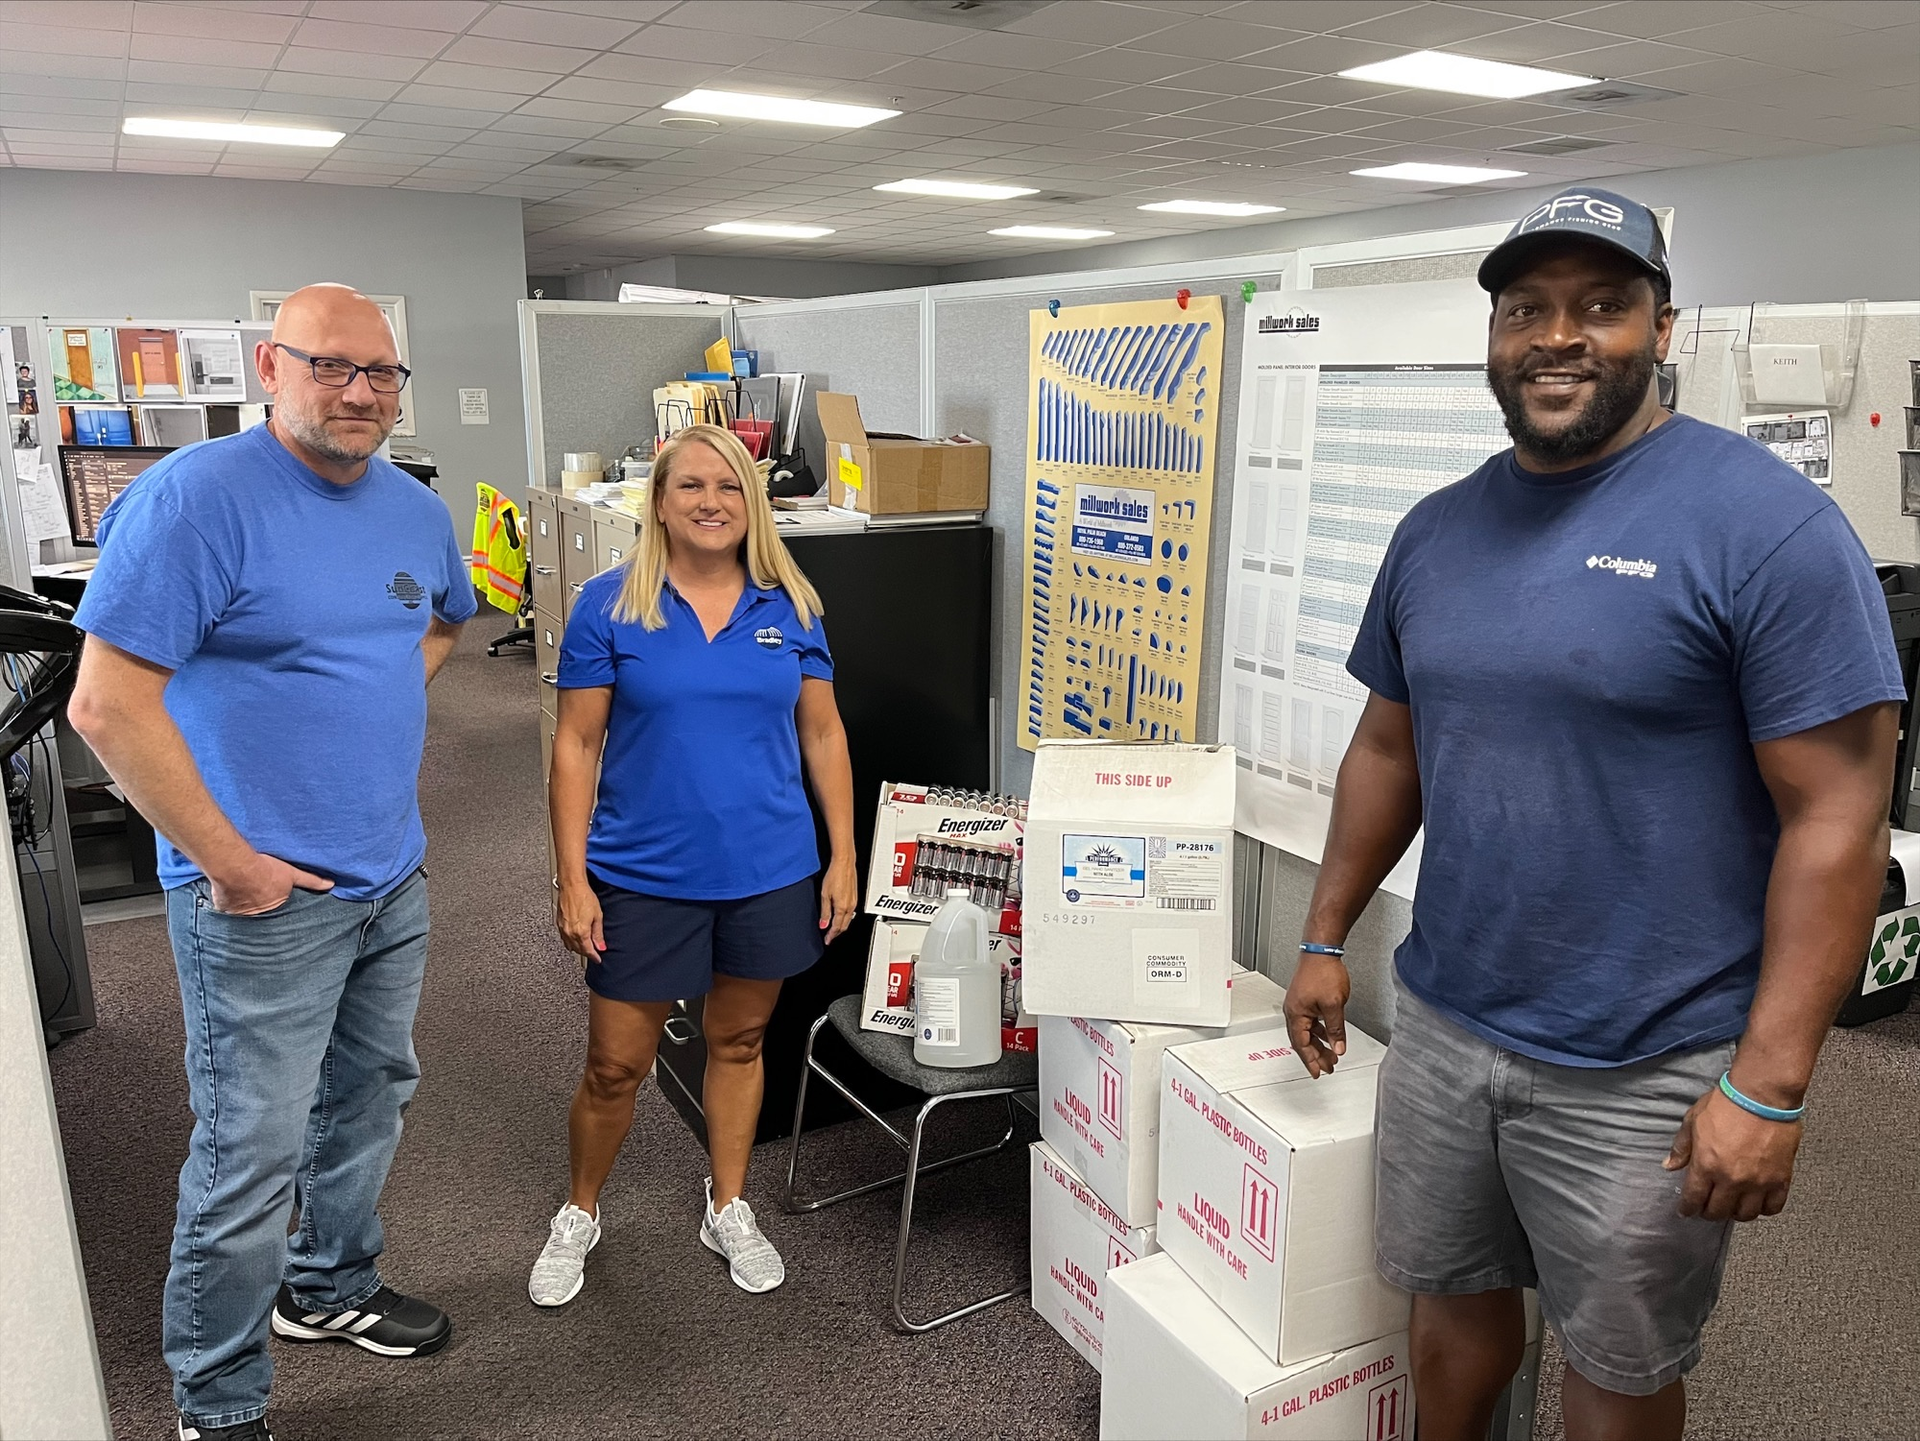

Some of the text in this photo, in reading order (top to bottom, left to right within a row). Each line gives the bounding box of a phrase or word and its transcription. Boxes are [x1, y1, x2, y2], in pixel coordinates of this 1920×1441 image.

[1518, 195, 1623, 235] PFG
[1259, 314, 1320, 329] millwork sales
[1080, 495, 1148, 518] millwork sales
[1598, 556, 1657, 572] Columbia
[1095, 773, 1172, 788] THIS SIDE UP
[938, 817, 1008, 835] Energizer
[1176, 843, 1214, 852] PP-28176
[875, 894, 940, 915] Energizer
[1043, 914, 1095, 924] 549297
[1016, 1032, 1024, 1044] C
[1090, 1026, 1115, 1057] BOTTLES
[1248, 1048, 1292, 1061] SIDE UP
[1065, 1087, 1091, 1125] LIQUID
[1171, 1078, 1267, 1165] 4-1 GAL. PLASTIC BOTTLES
[1054, 1097, 1104, 1158] HANDLE WITH CARE
[1043, 1160, 1128, 1236] 4-1 GAL. PLASTIC BOTTLES
[1195, 1192, 1230, 1240] LIQUID
[1178, 1202, 1248, 1280] HANDLE WITH CARE
[1066, 1257, 1098, 1298] LIQUID
[1050, 1265, 1104, 1323] HANDLE WITH CA
[1261, 1355, 1394, 1426] 4-1 GAL. PLASTIC BOTTLES
